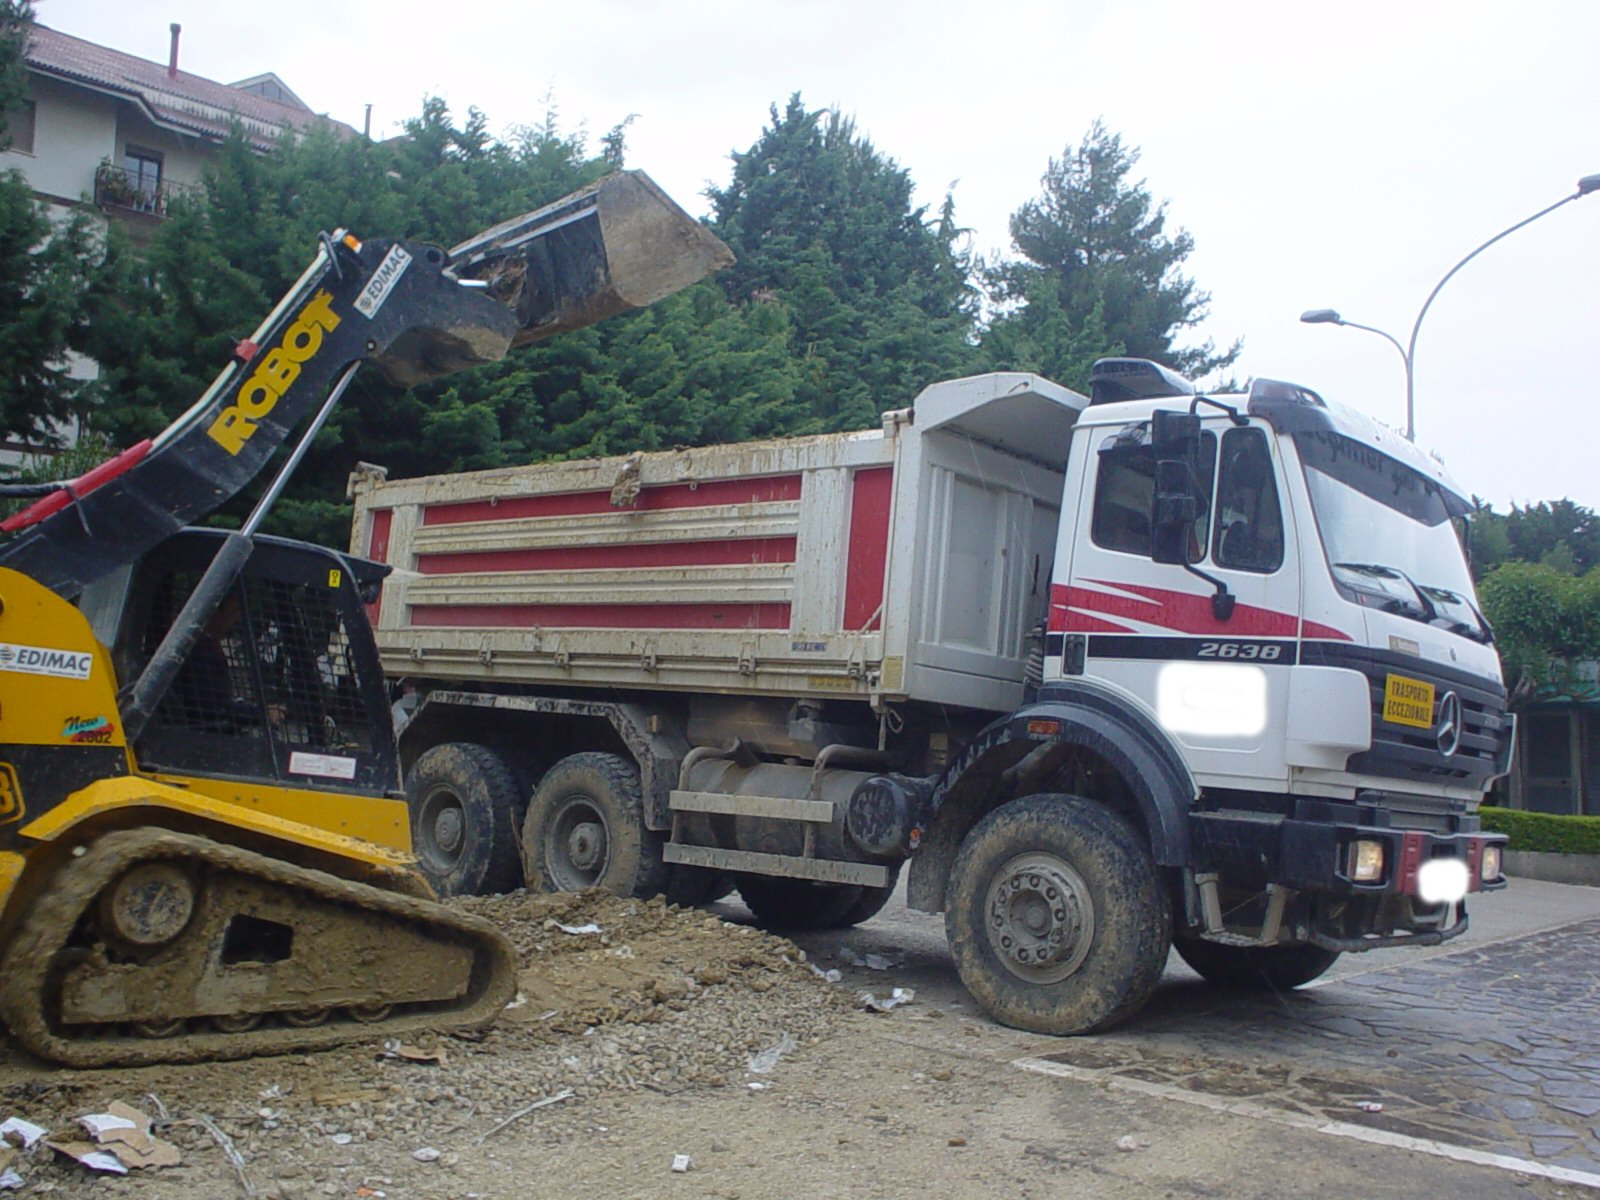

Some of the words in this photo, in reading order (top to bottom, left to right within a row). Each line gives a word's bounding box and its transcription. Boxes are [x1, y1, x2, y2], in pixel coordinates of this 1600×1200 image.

[367, 246, 406, 300] EDIMAC
[207, 288, 342, 456] ROBOT
[16, 649, 91, 672] EDIMAC
[1198, 643, 1282, 660] 2638
[1391, 681, 1429, 703] TRASPORTO
[1387, 700, 1430, 722] ECCEZIONALE
